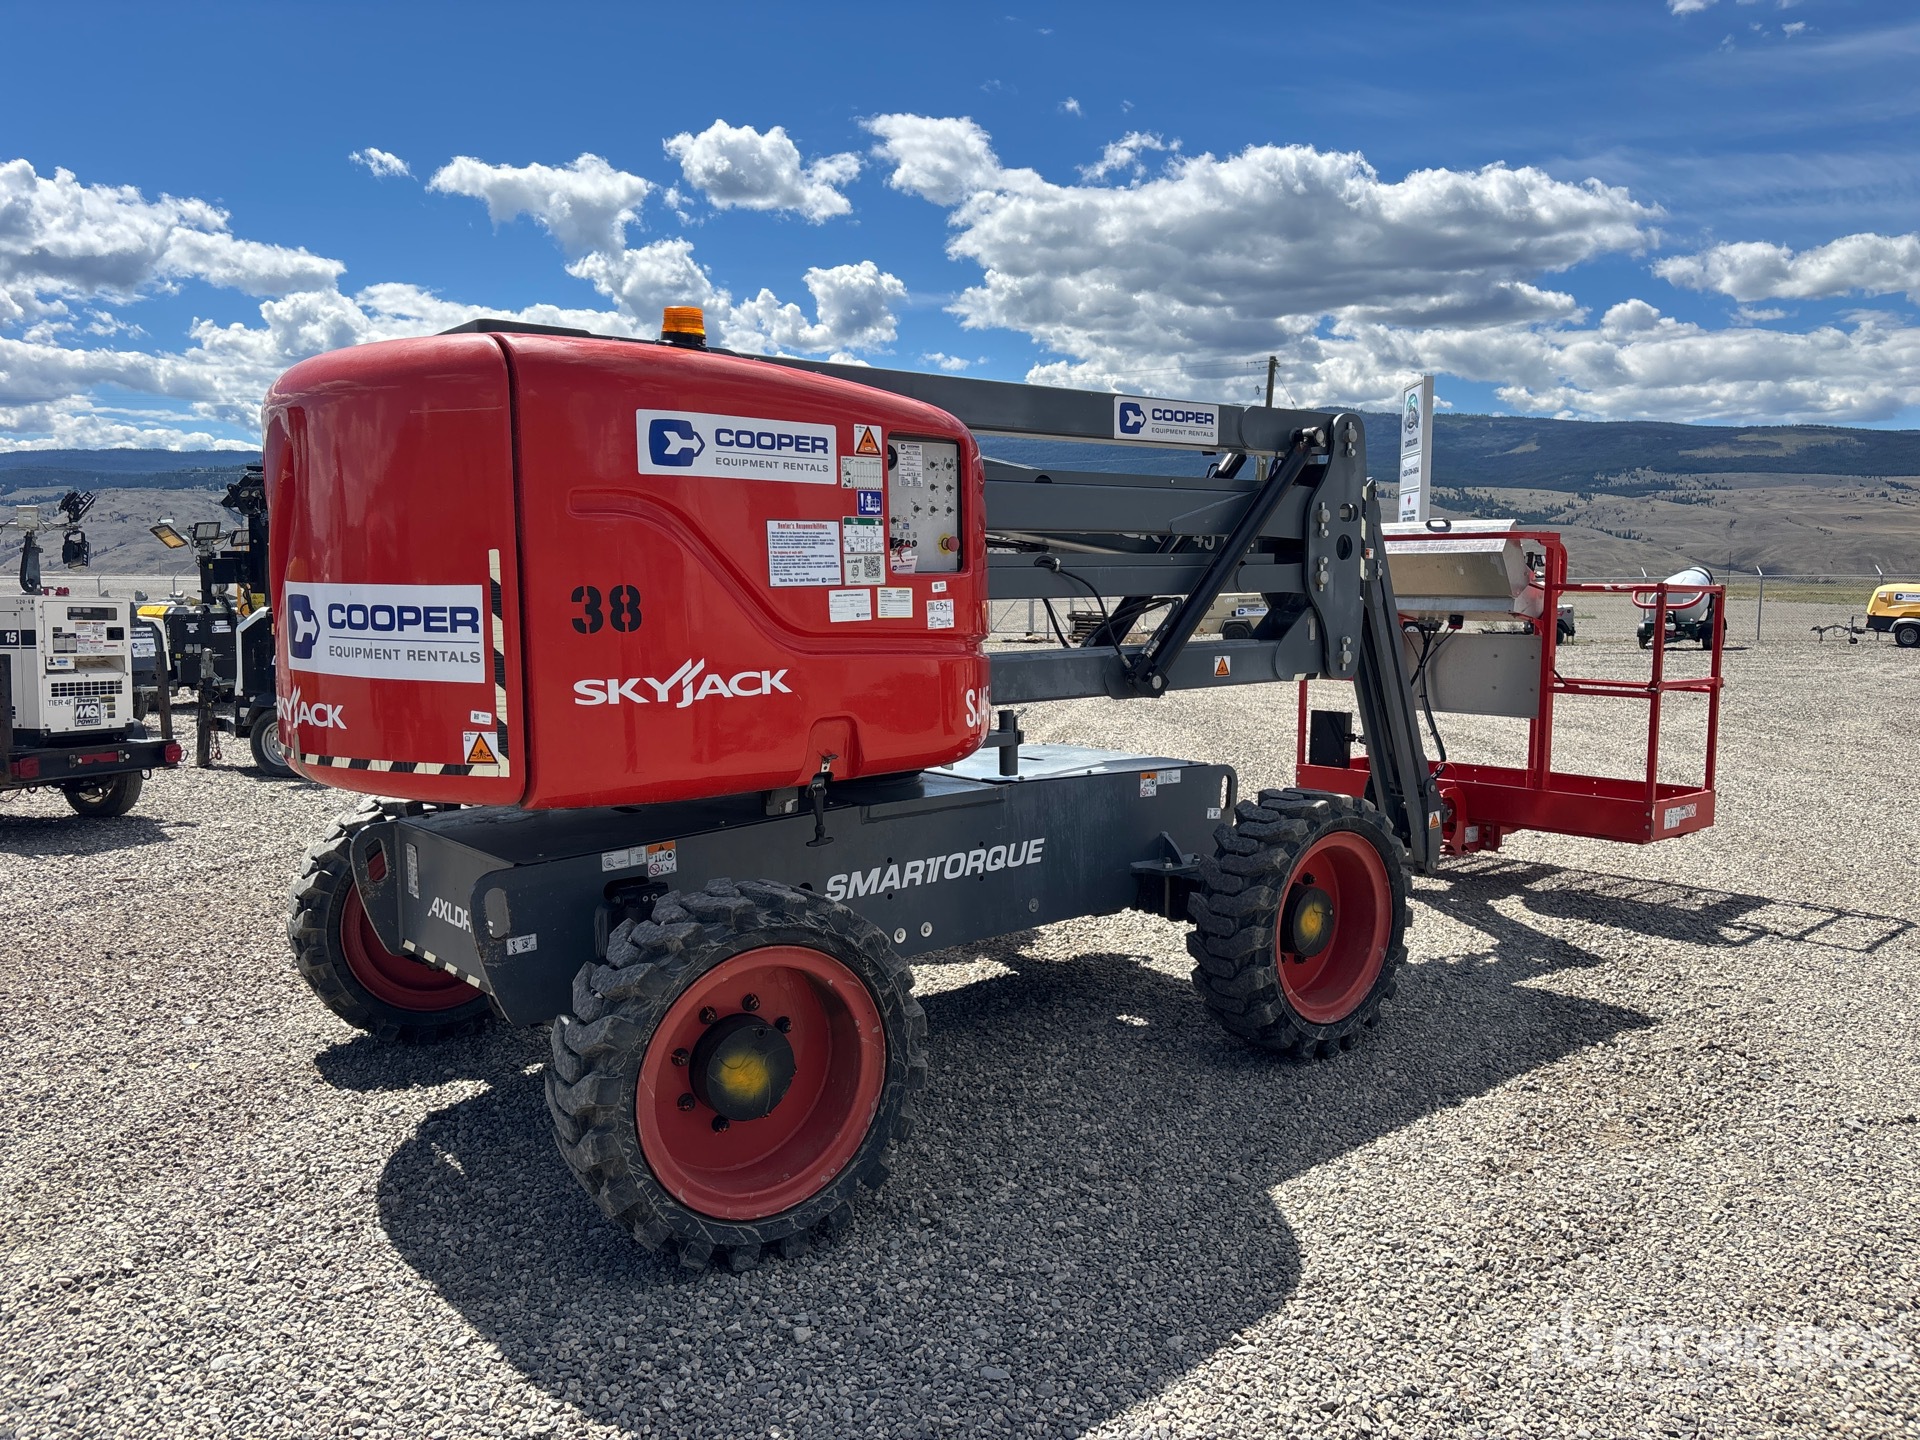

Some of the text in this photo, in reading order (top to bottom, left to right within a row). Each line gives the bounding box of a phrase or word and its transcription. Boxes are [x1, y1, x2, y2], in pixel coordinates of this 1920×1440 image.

[1151, 408, 1214, 425] COOPER
[714, 428, 829, 454] COOPER
[1151, 428, 1186, 436] EQUIPMENT
[715, 457, 779, 470] EQUIPMENT
[783, 461, 829, 473] RENTALS
[328, 603, 480, 634] COOPER
[571, 585, 642, 634] 38
[5, 632, 17, 643] 15
[328, 645, 481, 664] EQUIPMENT RENTALS
[573, 658, 793, 709] SKYJACK
[76, 705, 99, 718] MQ
[825, 838, 1046, 901] SMARTORQUE
[427, 896, 472, 934] AXLDR
